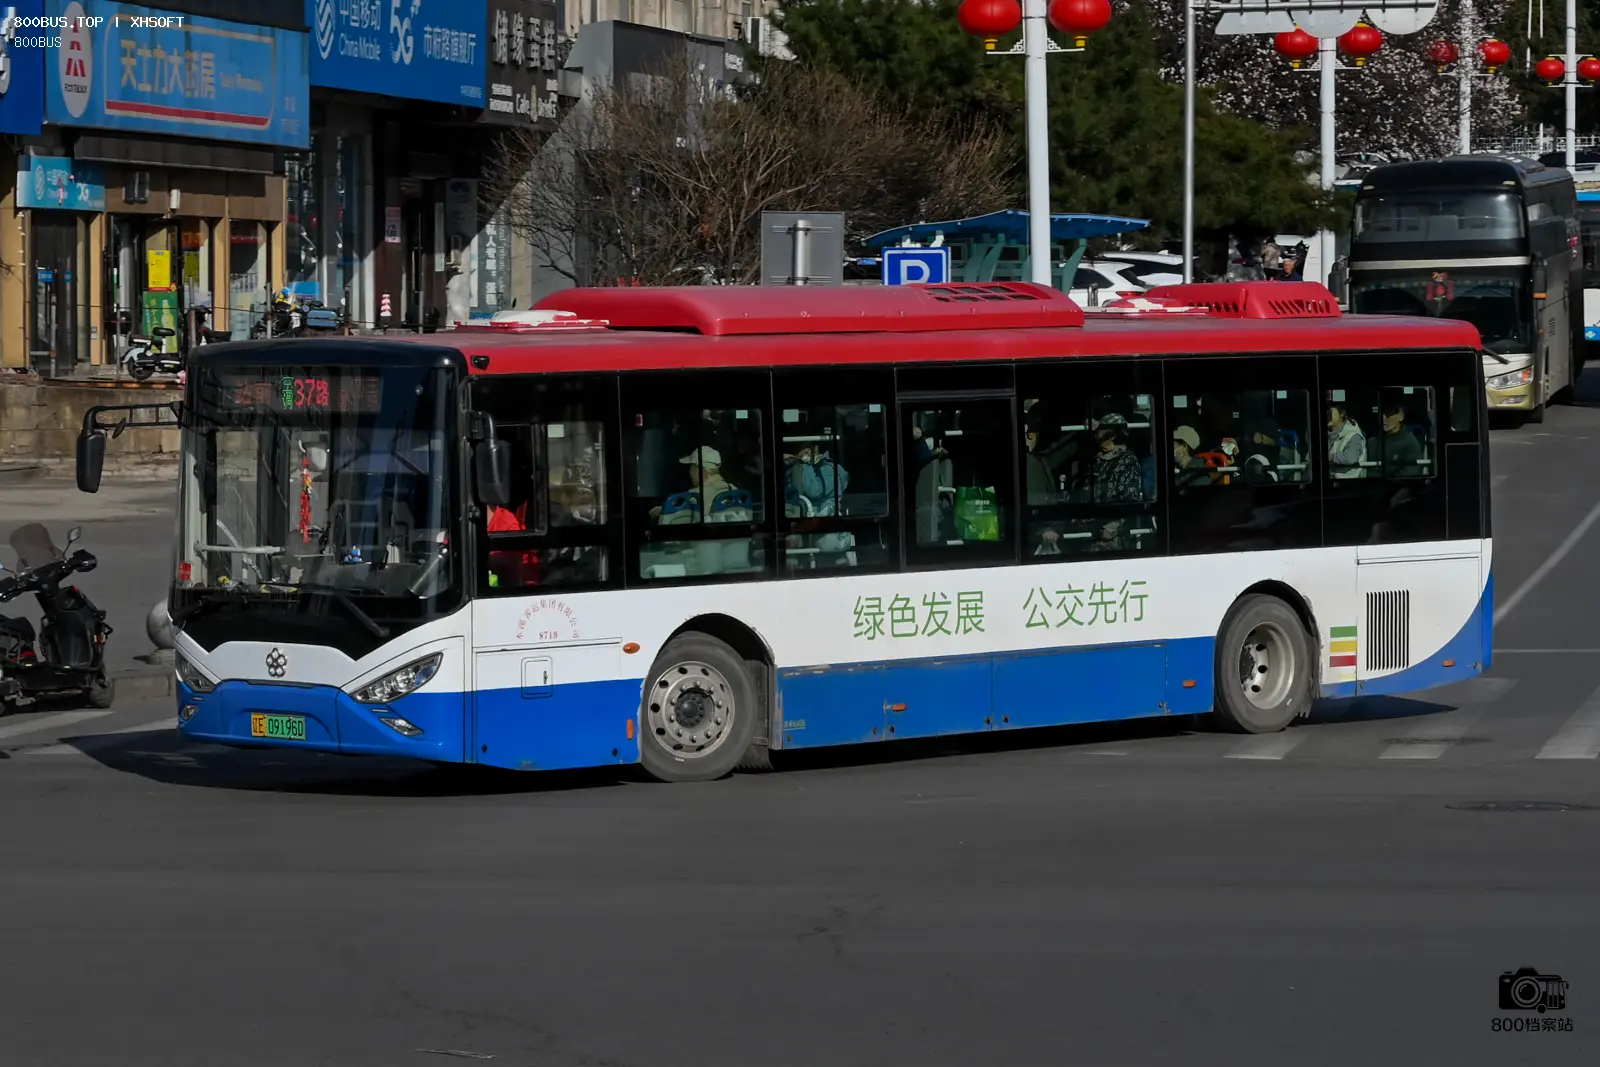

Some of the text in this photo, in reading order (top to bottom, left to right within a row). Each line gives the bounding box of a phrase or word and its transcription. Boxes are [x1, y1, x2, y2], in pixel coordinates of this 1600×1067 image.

[339, 33, 381, 61] China Mobile
[901, 259, 930, 284] P
[294, 378, 329, 406] 37路
[853, 589, 986, 641] 绿色发展
[1022, 579, 1149, 631] 公交先行
[538, 631, 558, 640] 8719
